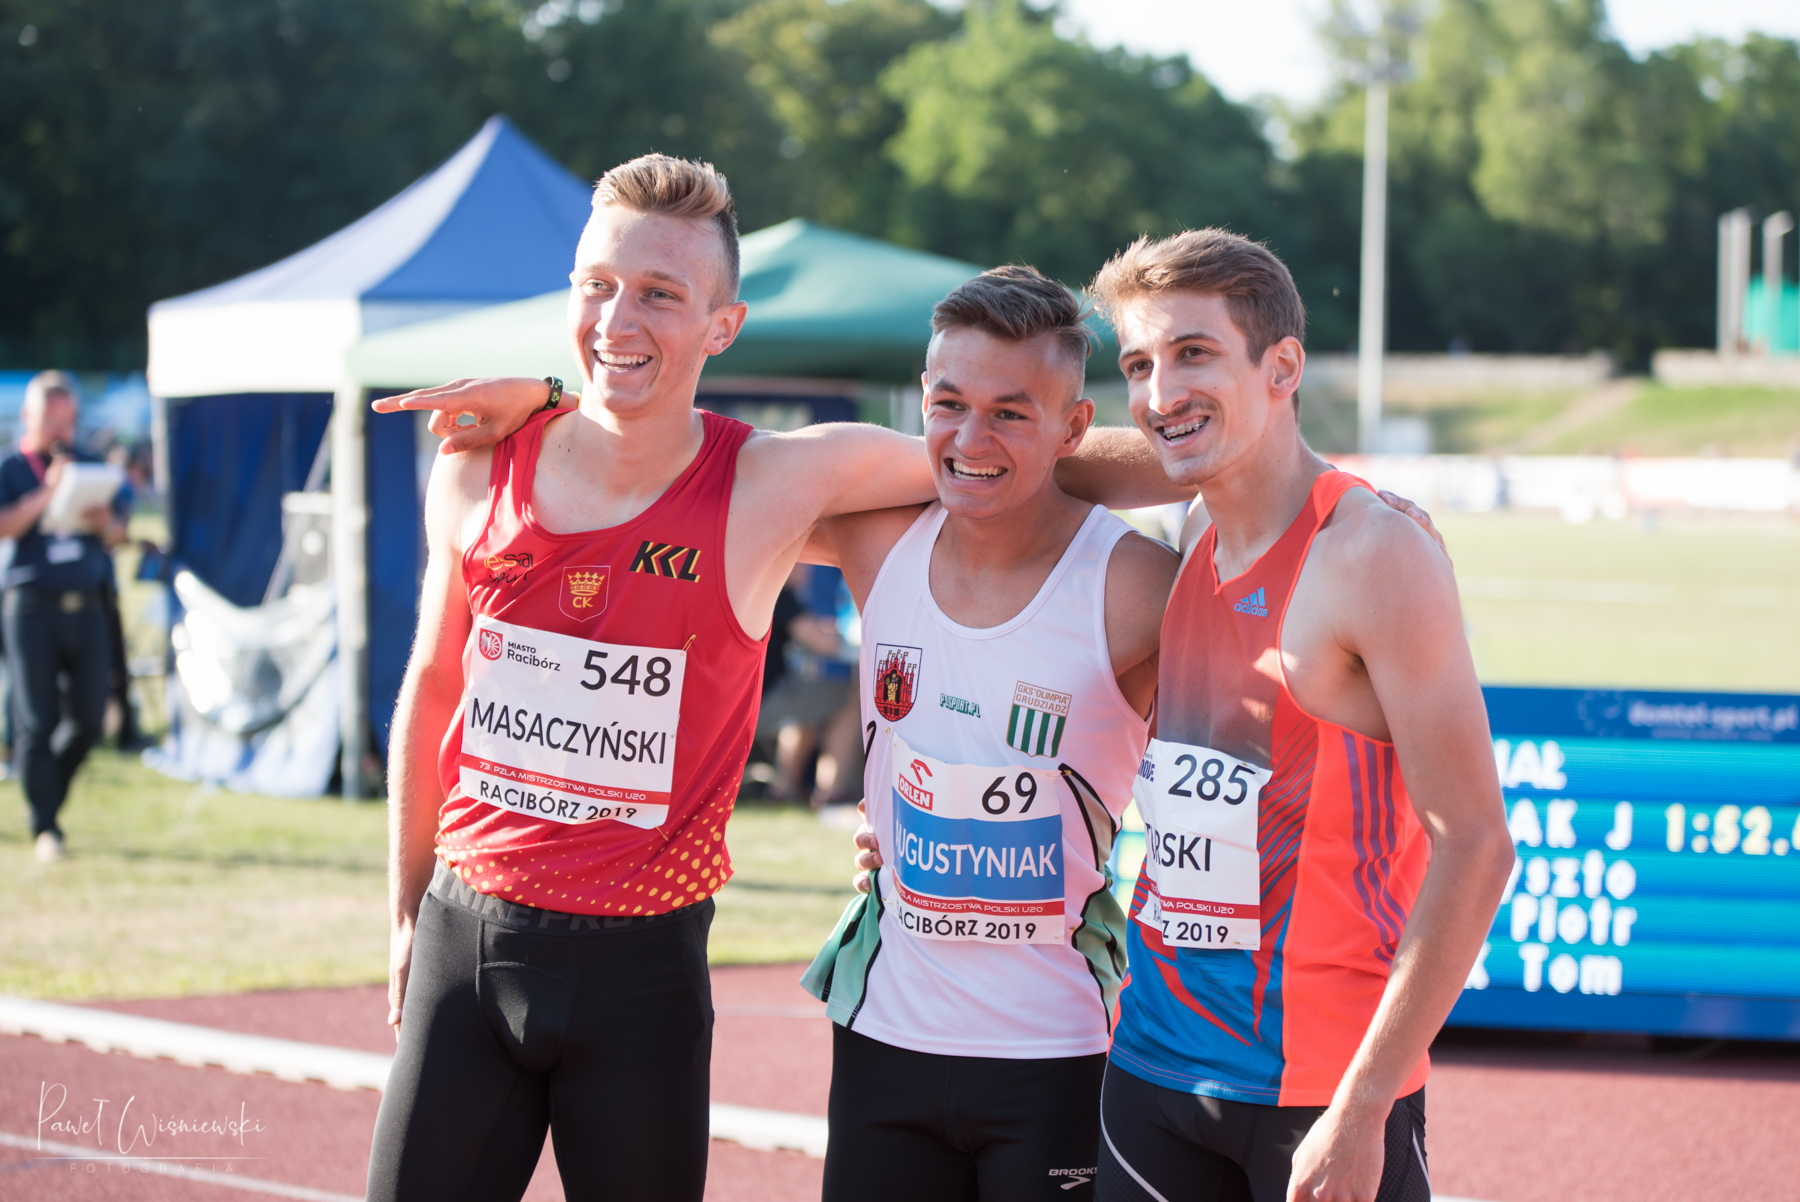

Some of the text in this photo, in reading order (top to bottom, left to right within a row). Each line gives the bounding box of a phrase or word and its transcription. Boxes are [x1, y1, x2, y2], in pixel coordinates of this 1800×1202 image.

[572, 596, 594, 608] CK
[1234, 603, 1268, 617] adidas
[507, 641, 537, 654] MIASTO
[507, 649, 561, 671] Racibórz
[580, 650, 671, 697] 548
[1018, 685, 1033, 696] GKS
[1015, 694, 1067, 713] GRUDZIĄDZ
[471, 697, 667, 764] MASACZYŃSKI
[480, 762, 491, 772] 73.
[493, 766, 516, 778] PZLA
[518, 772, 586, 793] MISTRZOSTWA
[588, 787, 623, 799] POLSKI
[1168, 754, 1256, 805] 285
[480, 780, 638, 821] RACIBÓRZ 2019
[900, 777, 930, 808] ORLEN
[982, 772, 1037, 815] 69
[913, 897, 982, 911] MISTRZOSTWA
[984, 904, 1019, 913] POLSKI
[1176, 902, 1211, 913] POLSKI
[985, 922, 1037, 940] 2019
[1176, 921, 1229, 943] 2019
[1518, 941, 1623, 995] Tom
